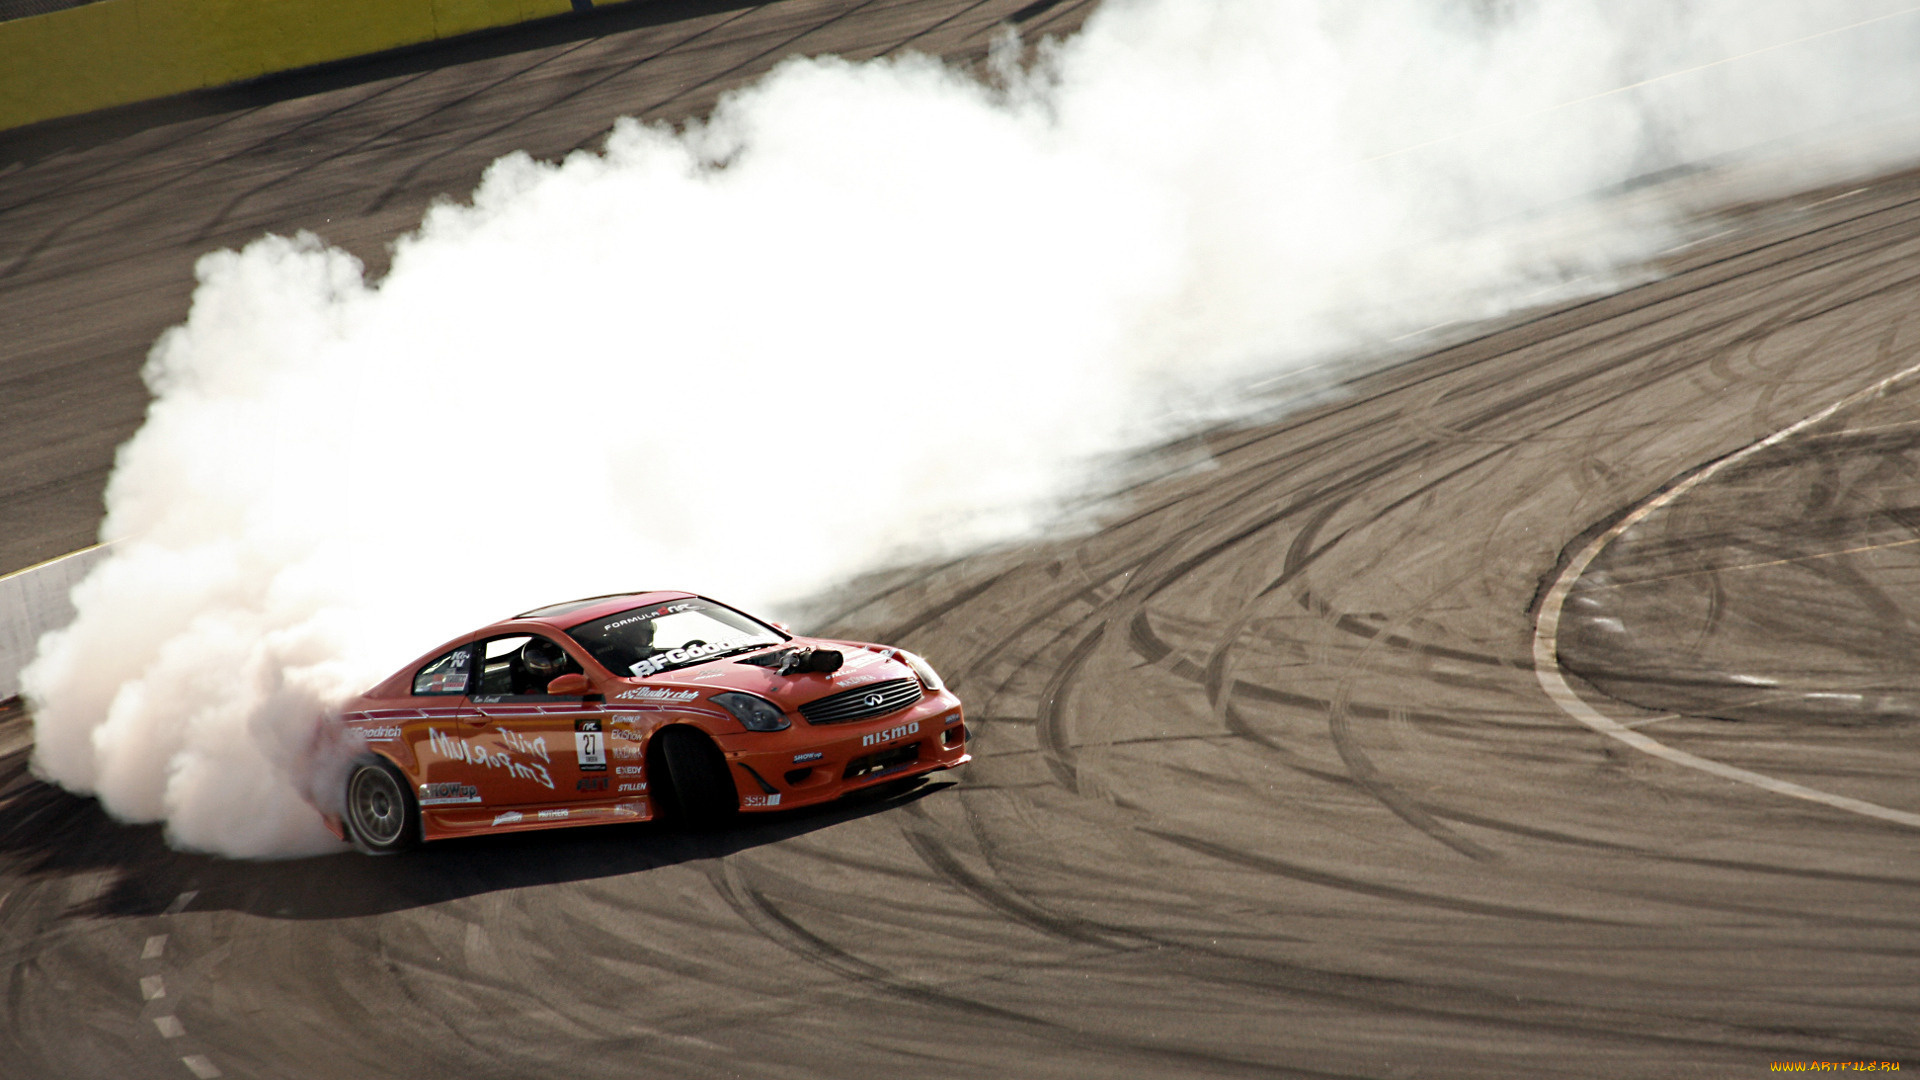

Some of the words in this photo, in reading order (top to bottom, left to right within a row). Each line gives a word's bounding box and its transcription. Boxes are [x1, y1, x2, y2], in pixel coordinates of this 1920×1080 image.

[604, 611, 661, 631] FORMULA
[583, 734, 596, 755] 27
[862, 722, 919, 747] nismo
[615, 766, 642, 775] EXEDY
[617, 782, 647, 792] STILLEN
